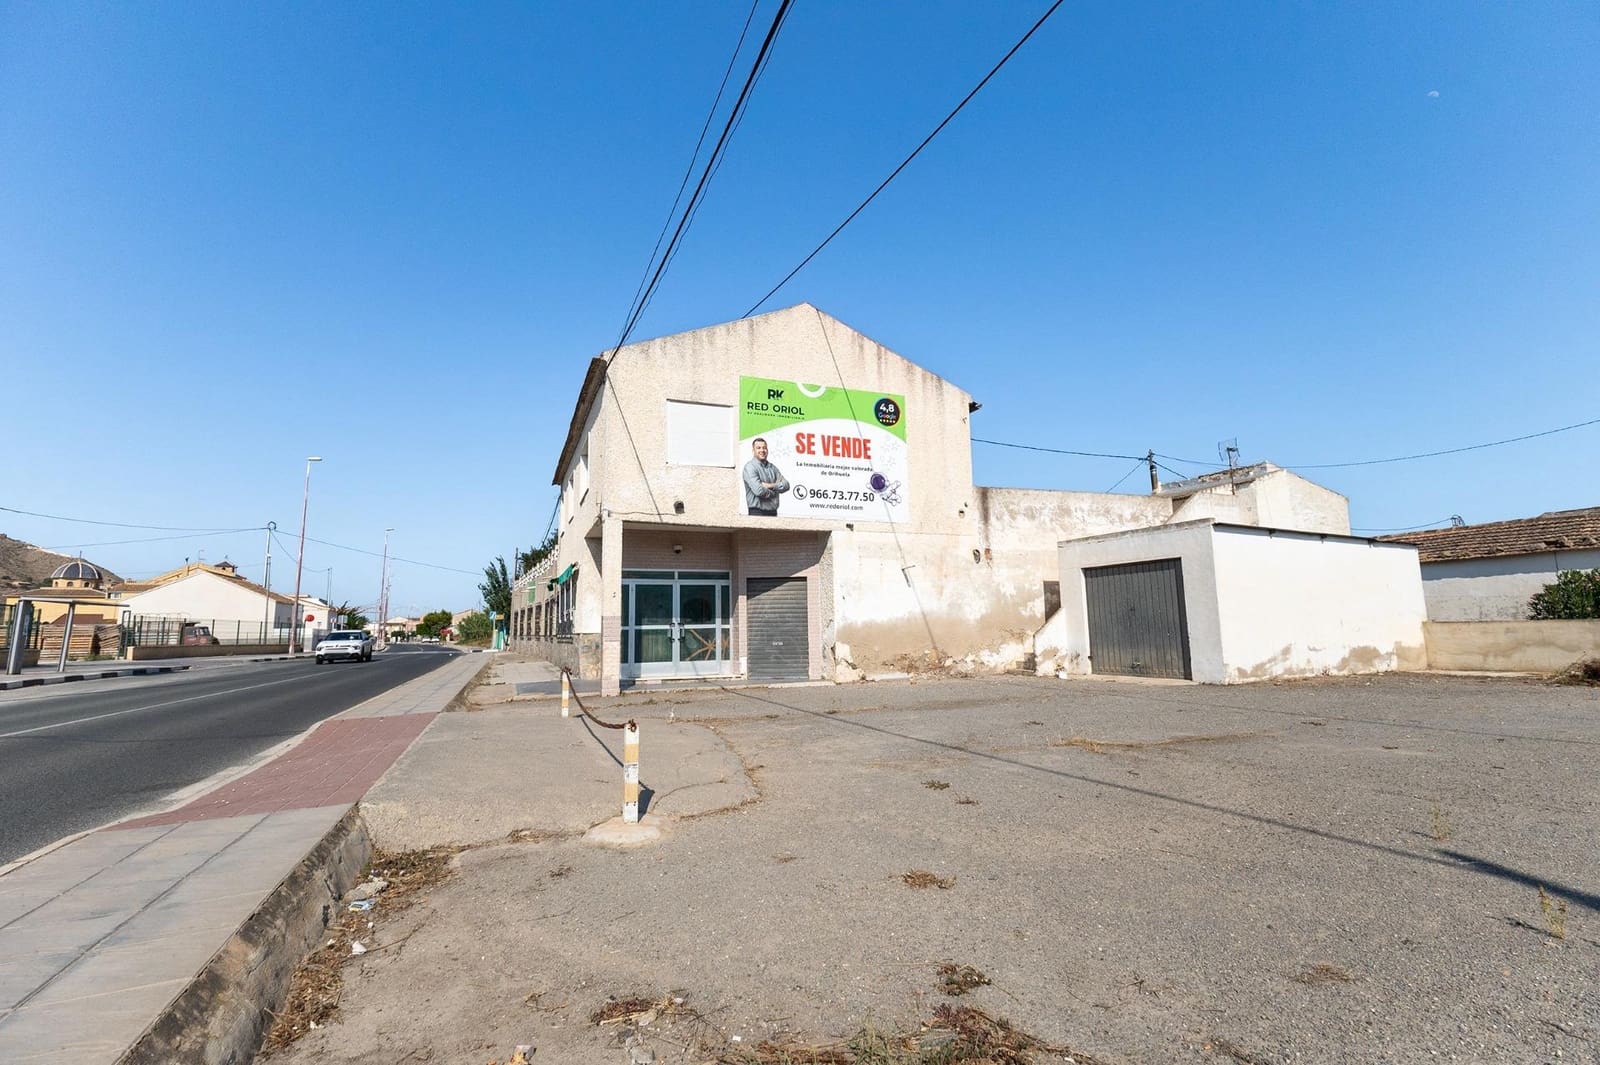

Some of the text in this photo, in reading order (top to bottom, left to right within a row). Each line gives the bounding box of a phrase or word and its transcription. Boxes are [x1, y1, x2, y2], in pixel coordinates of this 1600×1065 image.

[747, 402, 768, 411] RED
[773, 404, 804, 416] ORIOL
[880, 403, 894, 413] 4,8
[796, 432, 872, 460] SE VENDE
[809, 488, 875, 502] 966.73.77.50
